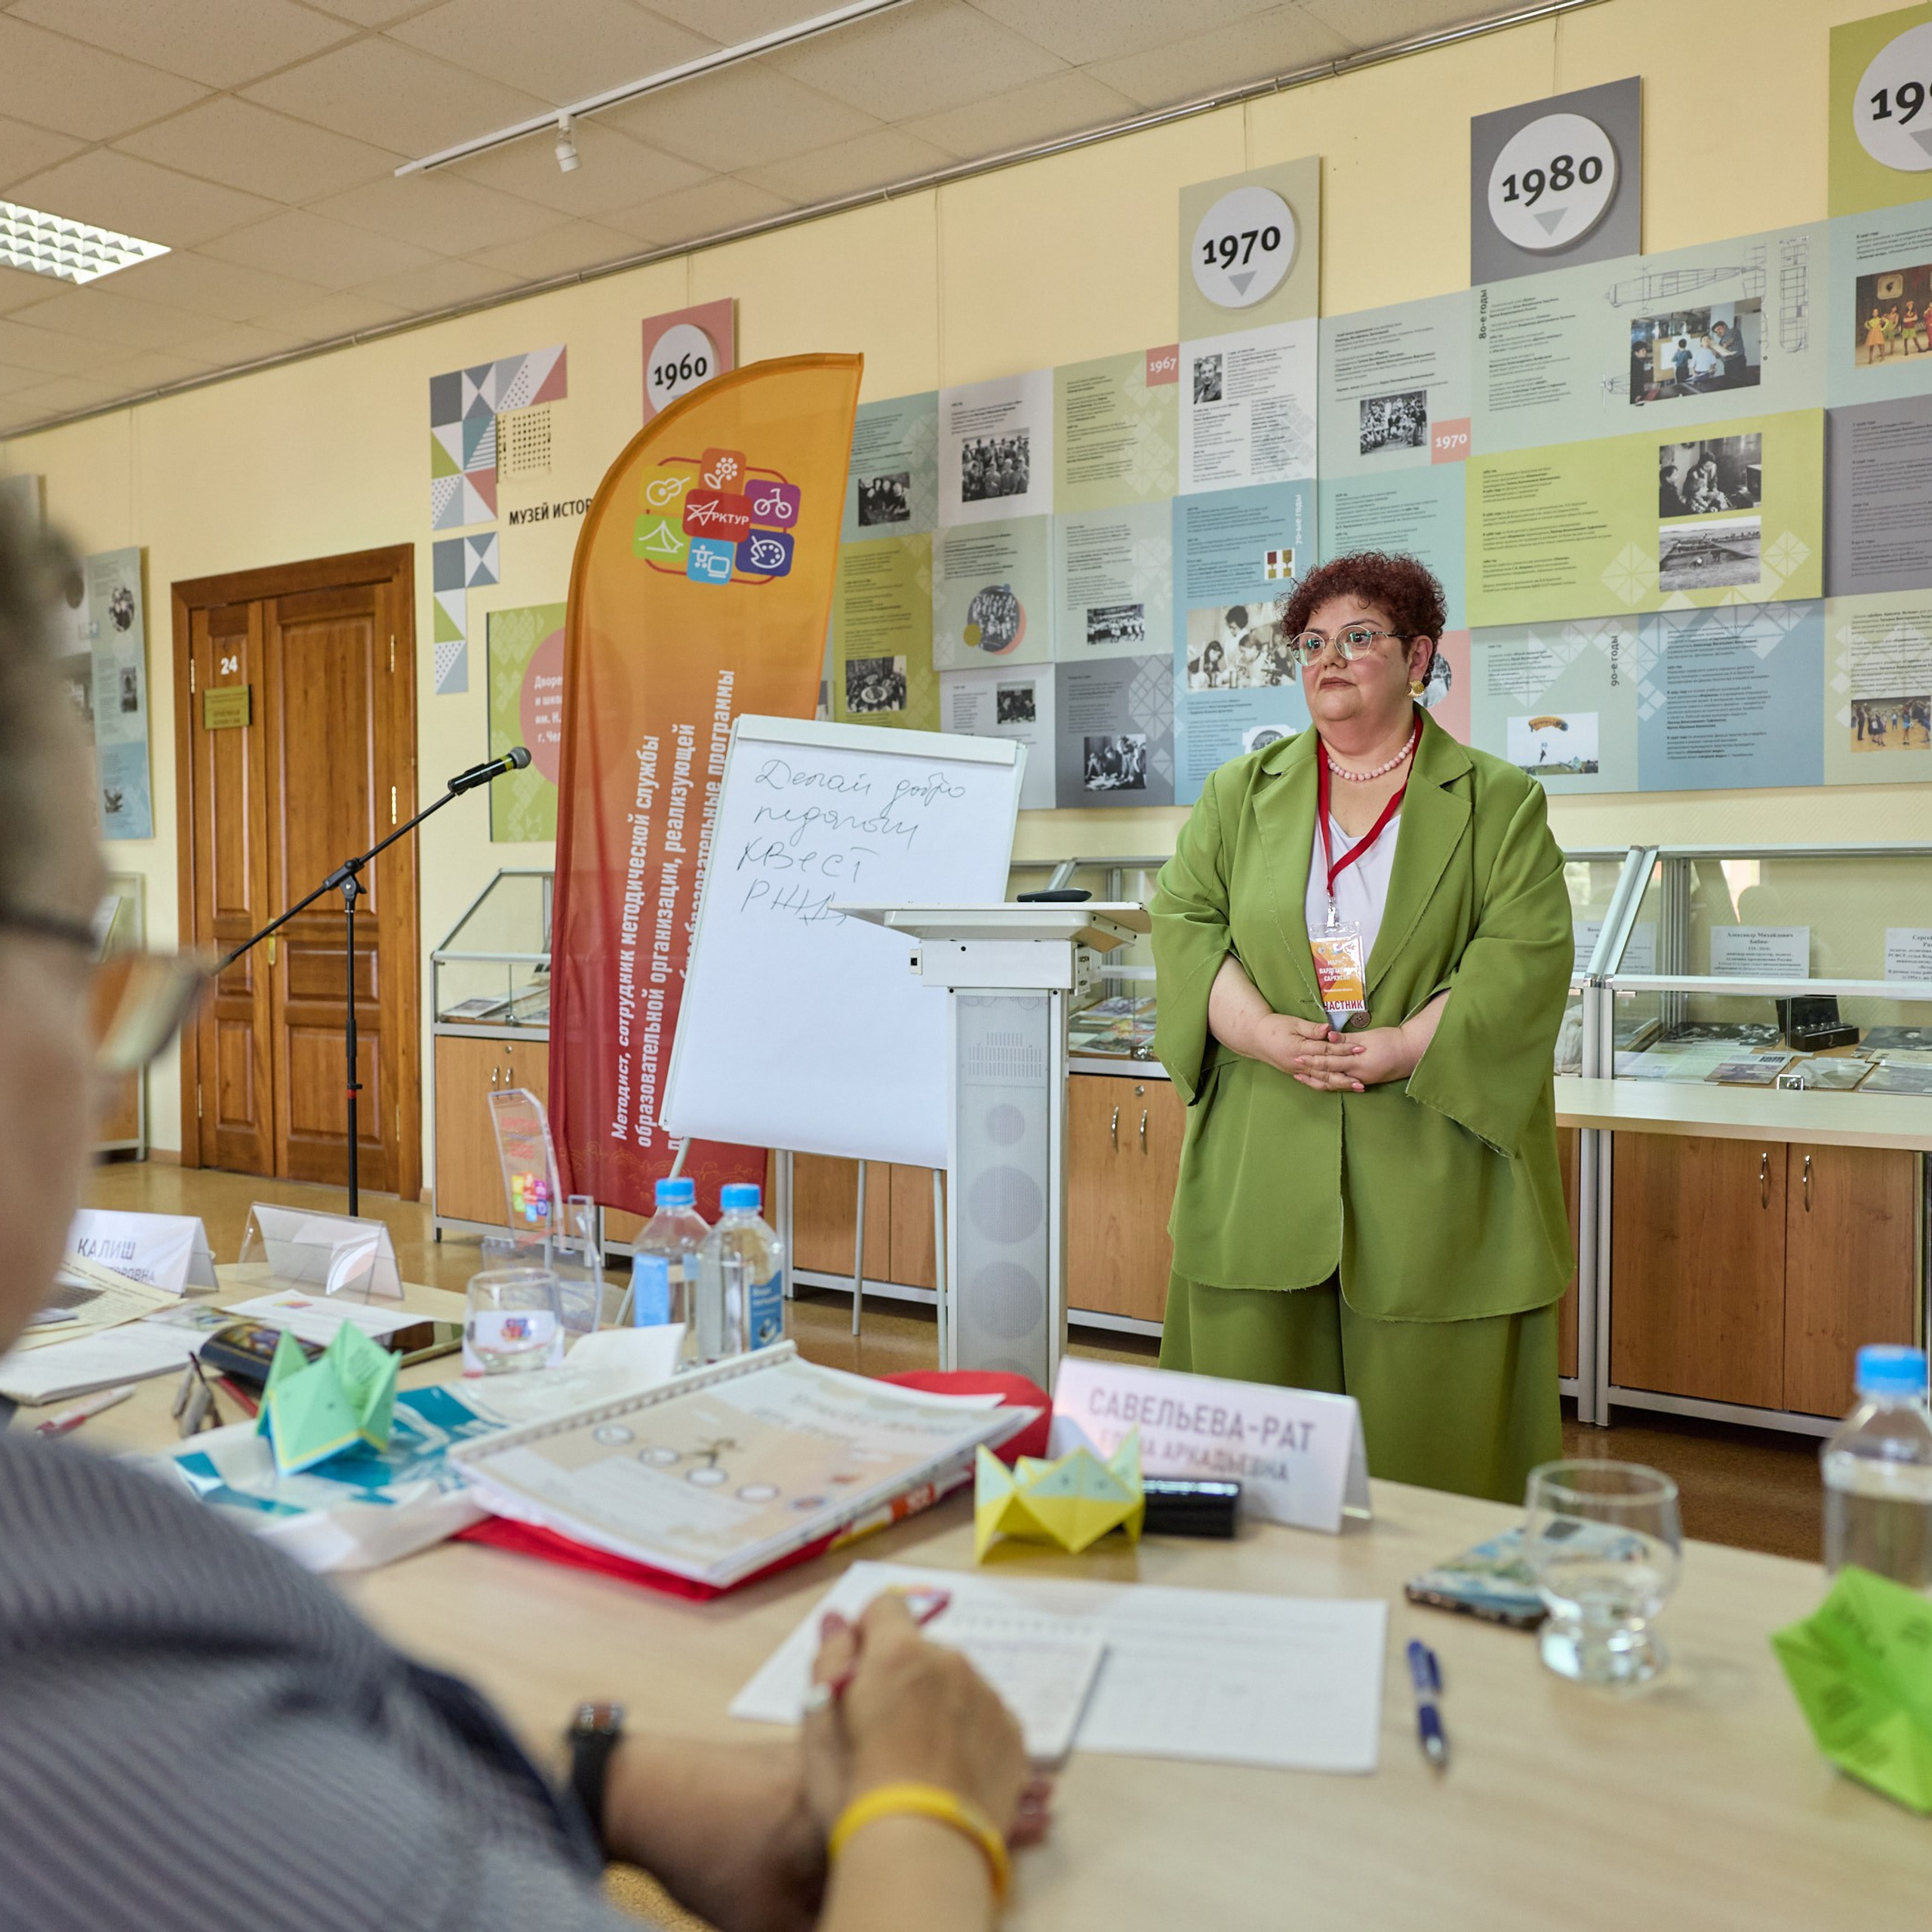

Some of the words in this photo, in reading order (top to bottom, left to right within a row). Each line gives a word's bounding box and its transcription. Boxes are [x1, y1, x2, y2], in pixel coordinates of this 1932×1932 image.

[1870, 81, 1932, 125] 19
[1502, 155, 1603, 207] 1980
[1202, 226, 1281, 269] 1970
[1480, 289, 1488, 315] годы
[654, 355, 708, 391] 1960
[1149, 357, 1177, 373] 1967
[1435, 432, 1468, 449] 1970
[509, 501, 549, 526] МУЗЕЙ
[220, 655, 238, 675] 24
[1611, 635, 1619, 662] годы
[707, 670, 735, 776] программы
[636, 735, 660, 809] службы
[665, 723, 695, 853] реализующей
[755, 759, 871, 795] Делай
[879, 772, 966, 819] добро
[621, 814, 651, 945] методической
[650, 857, 683, 983] организации,
[619, 949, 635, 1047] сотрудник
[635, 989, 665, 1147] образовательной
[611, 1053, 632, 1140] Методист,
[77, 1238, 137, 1260] КАЛИШ
[1088, 1387, 1316, 1452] САВЕЛЬЕВА-РАТ
